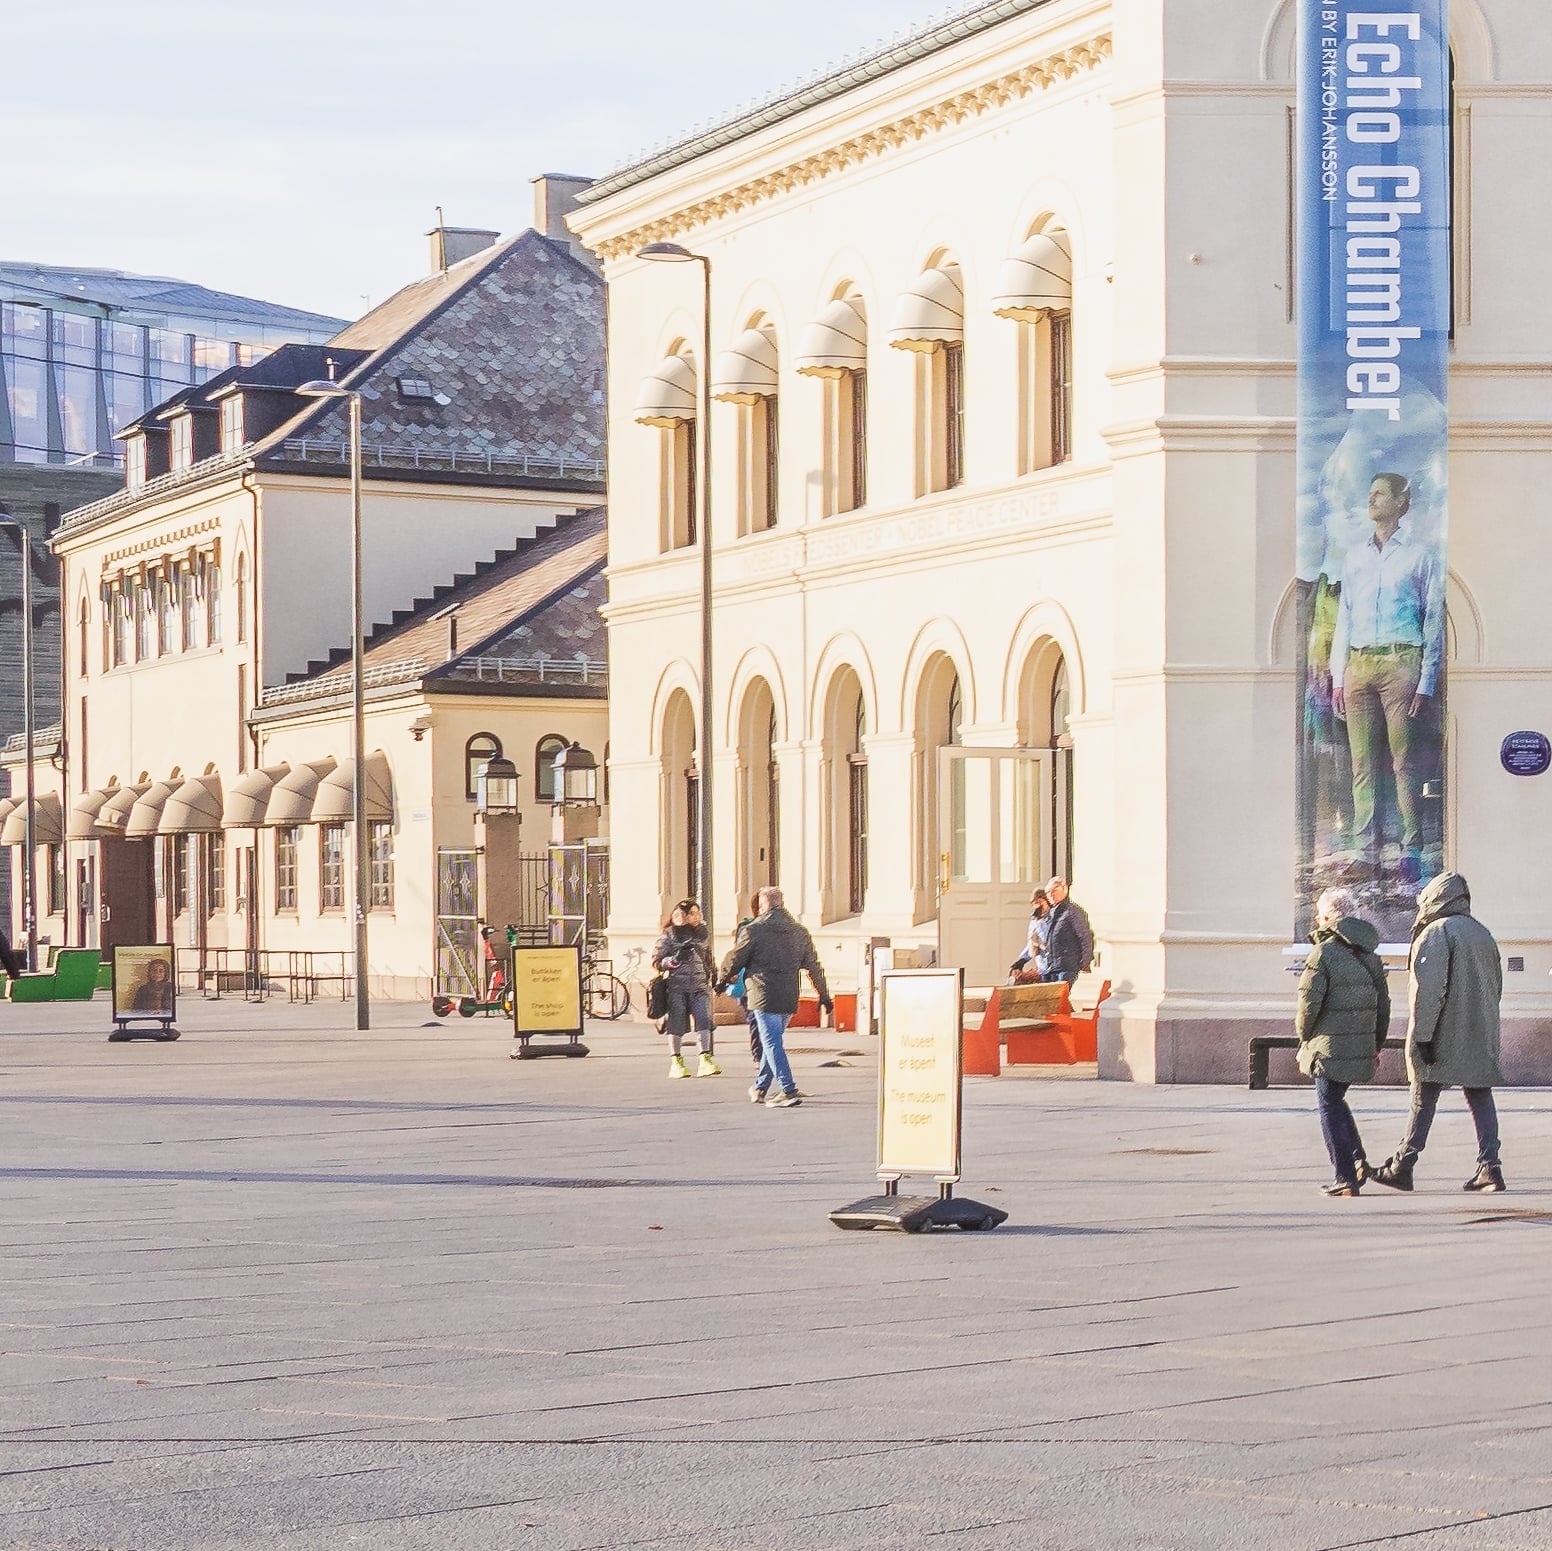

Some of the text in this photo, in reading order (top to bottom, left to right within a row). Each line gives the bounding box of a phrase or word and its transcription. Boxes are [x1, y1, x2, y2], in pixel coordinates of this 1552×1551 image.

[1321, 10, 1338, 33] BY
[1321, 37, 1338, 77] ERIK
[1346, 12, 1422, 143] Echo
[1321, 80, 1338, 201] JOHANSSON
[1345, 165, 1422, 421] Chamber
[901, 1034, 935, 1048] Museet
[891, 1088, 946, 1104] The museum
[910, 1113, 933, 1127] open
